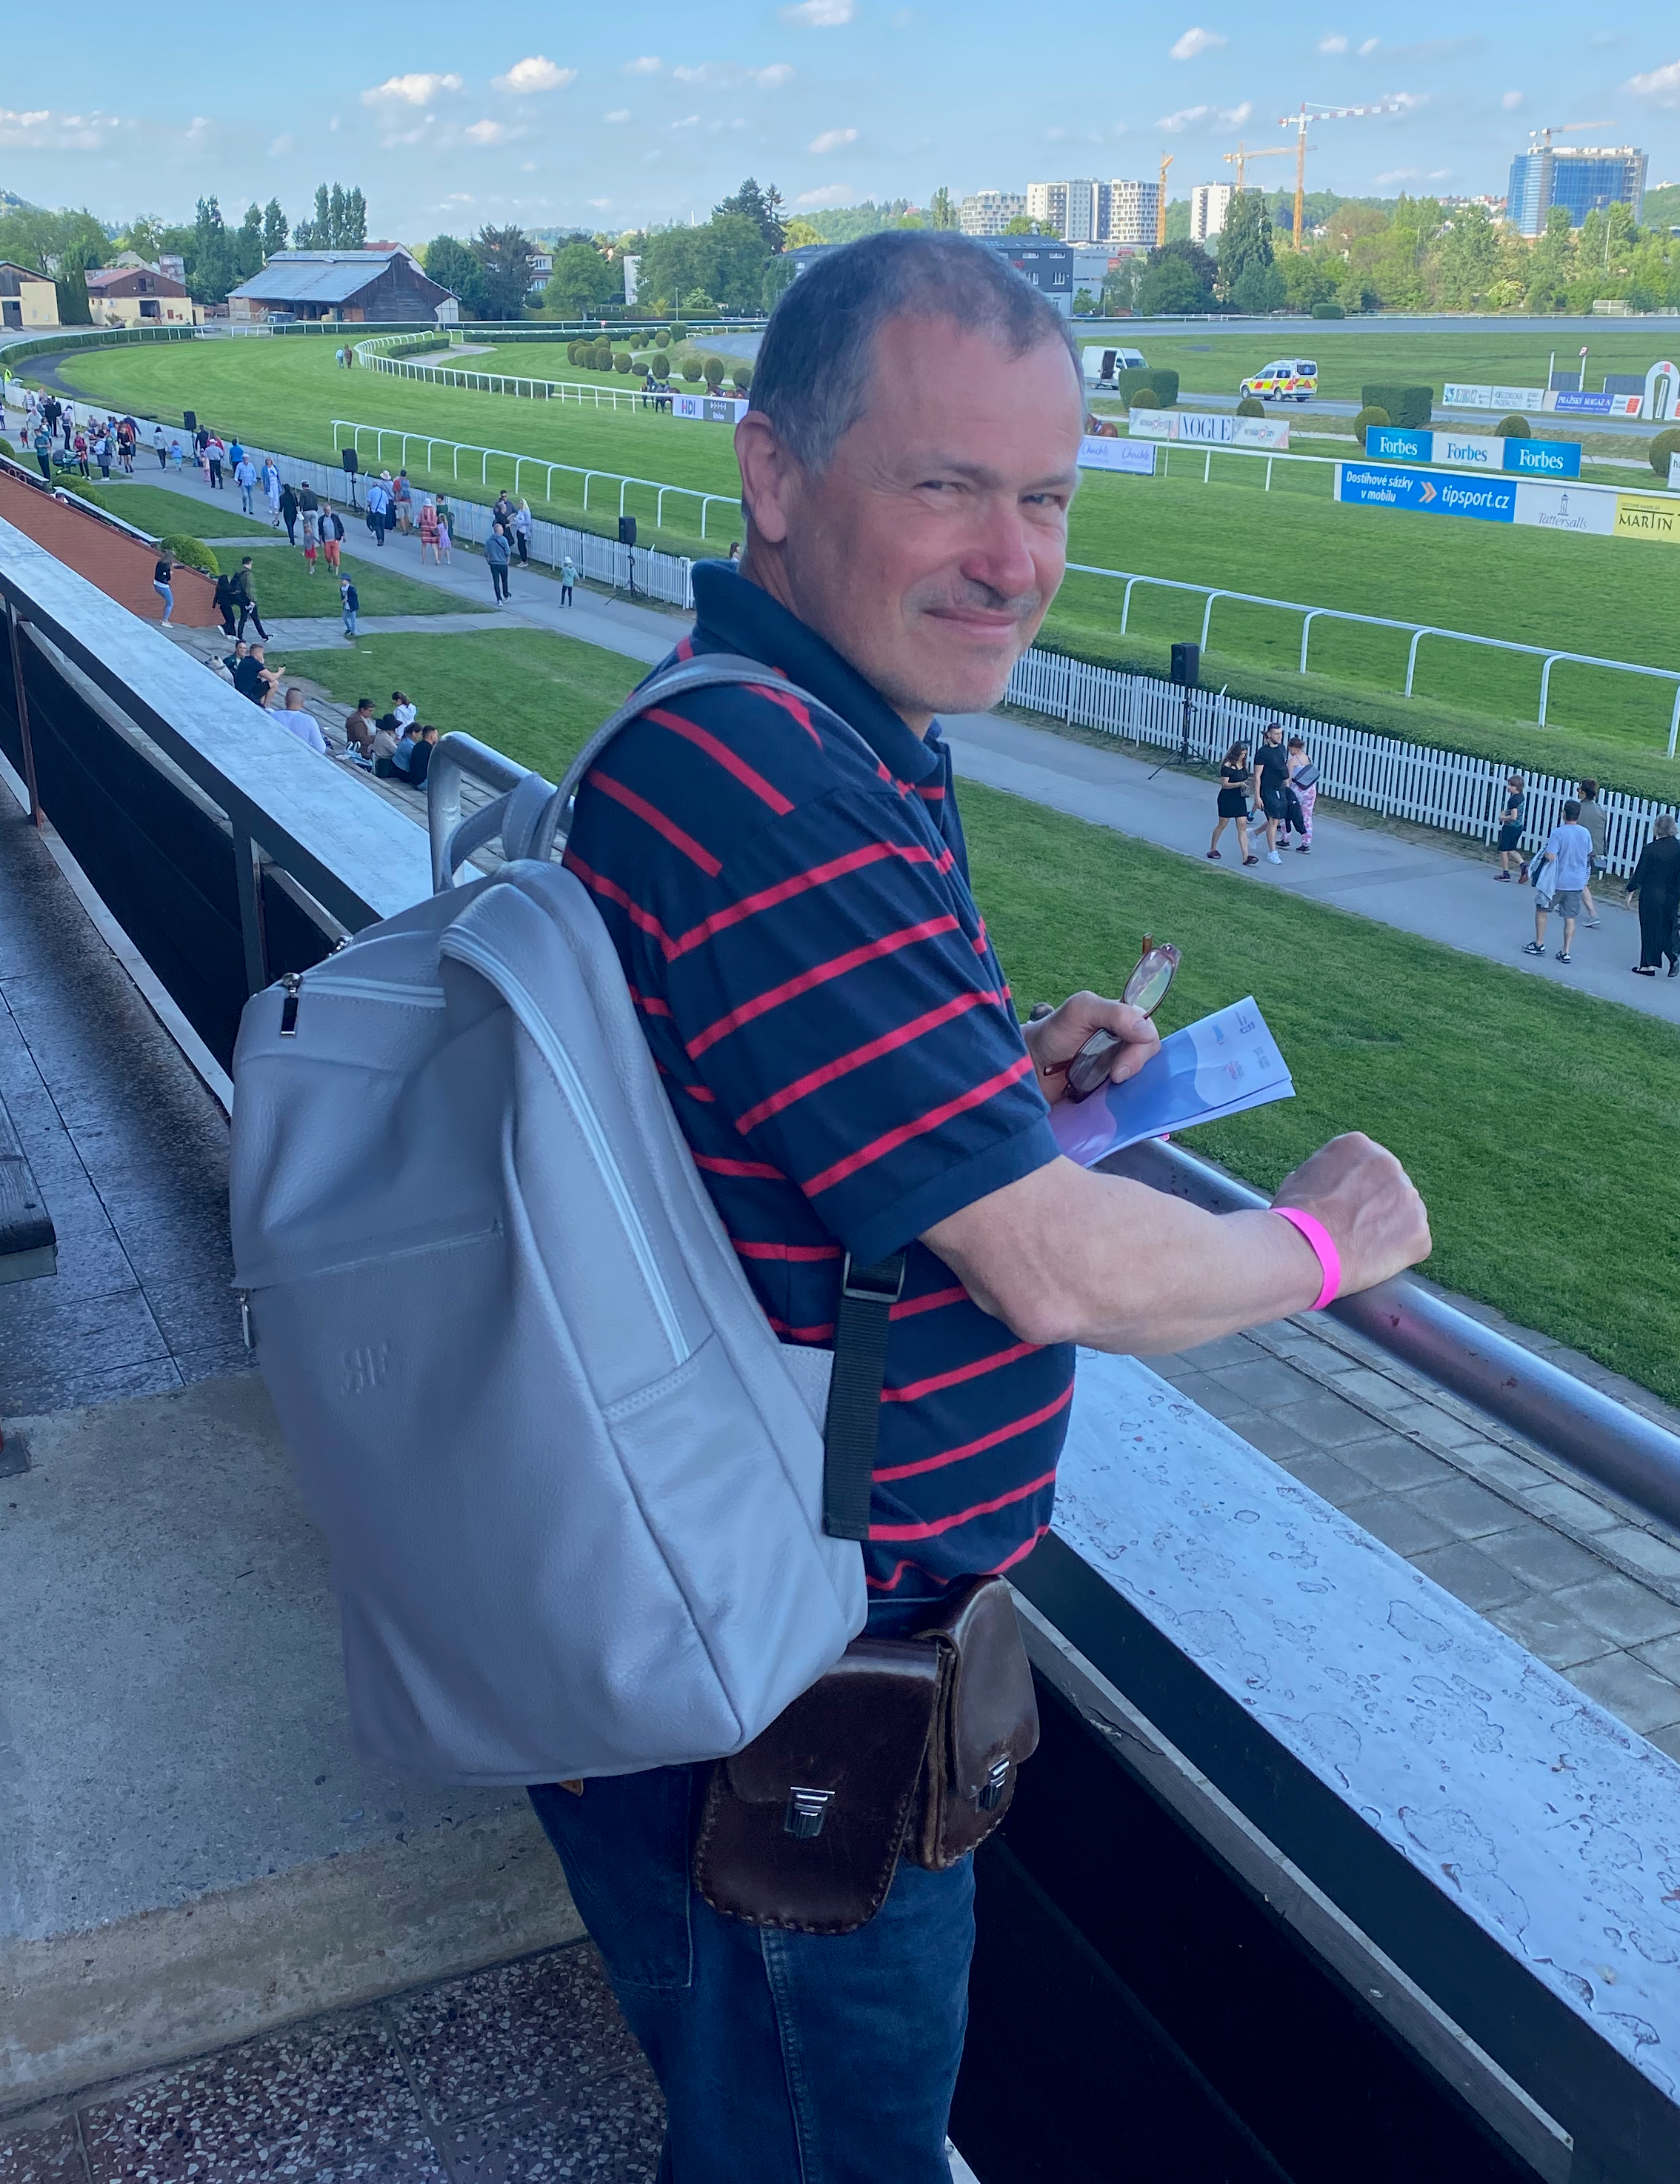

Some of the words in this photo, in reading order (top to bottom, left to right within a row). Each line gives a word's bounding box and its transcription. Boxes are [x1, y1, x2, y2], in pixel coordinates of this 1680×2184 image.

[681, 399, 696, 416] HDI
[1183, 416, 1230, 441] VOGUE
[1379, 436, 1418, 456] Forbes
[1447, 443, 1487, 462] Forbes
[1519, 448, 1564, 470] Forbes
[1346, 470, 1387, 487] Dostihové
[1388, 475, 1414, 492] sázky
[1361, 489, 1366, 499] v
[1367, 489, 1396, 502] mobilu
[1441, 485, 1510, 509] tipsport.cz
[1538, 513, 1587, 530] Tattersalls
[1619, 508, 1674, 531] MARTIN
